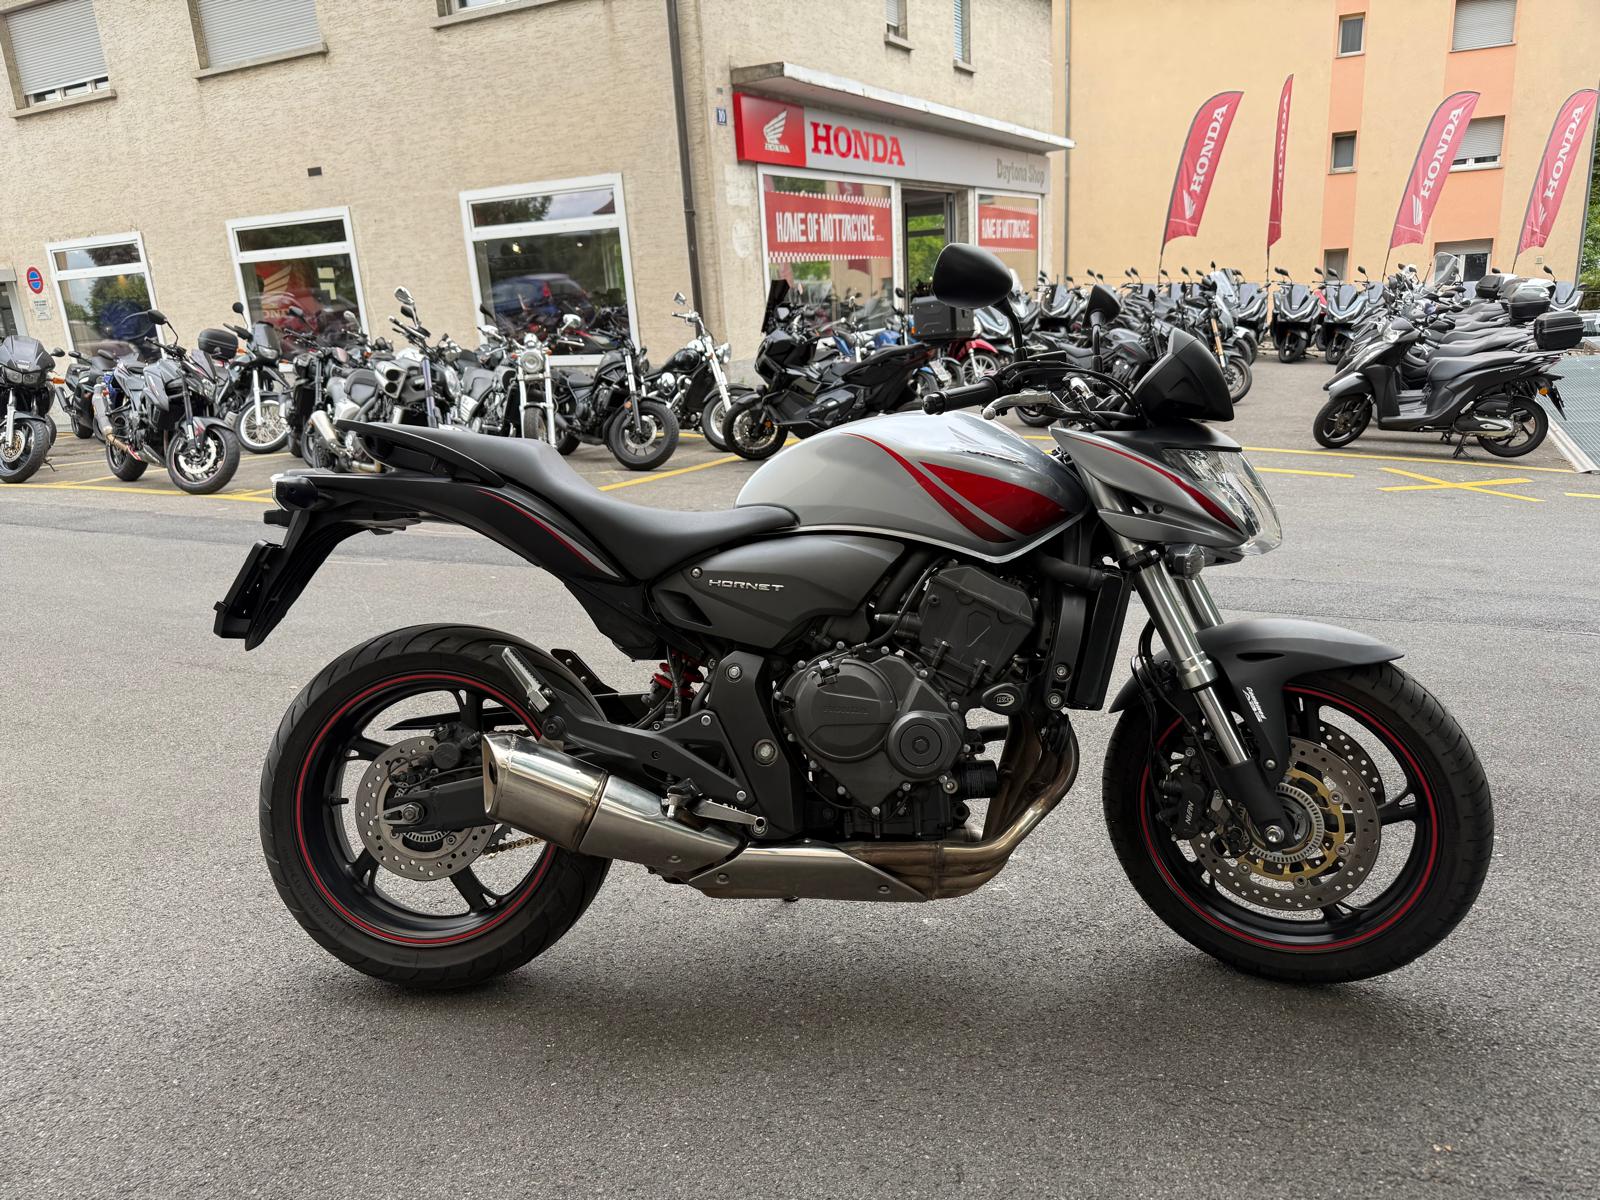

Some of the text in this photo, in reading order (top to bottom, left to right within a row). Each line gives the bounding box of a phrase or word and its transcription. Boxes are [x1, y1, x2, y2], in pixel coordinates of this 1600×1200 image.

[764, 143, 791, 154] HONDA
[810, 121, 905, 167] HONDA
[1190, 103, 1229, 194] HONDA
[1420, 106, 1464, 199] HONDA
[1543, 105, 1585, 200] HONDA
[996, 158, 1045, 188] Daytona Shop
[775, 211, 875, 243] HOME OF MOTORCYCLE
[708, 579, 785, 592] HORNET
